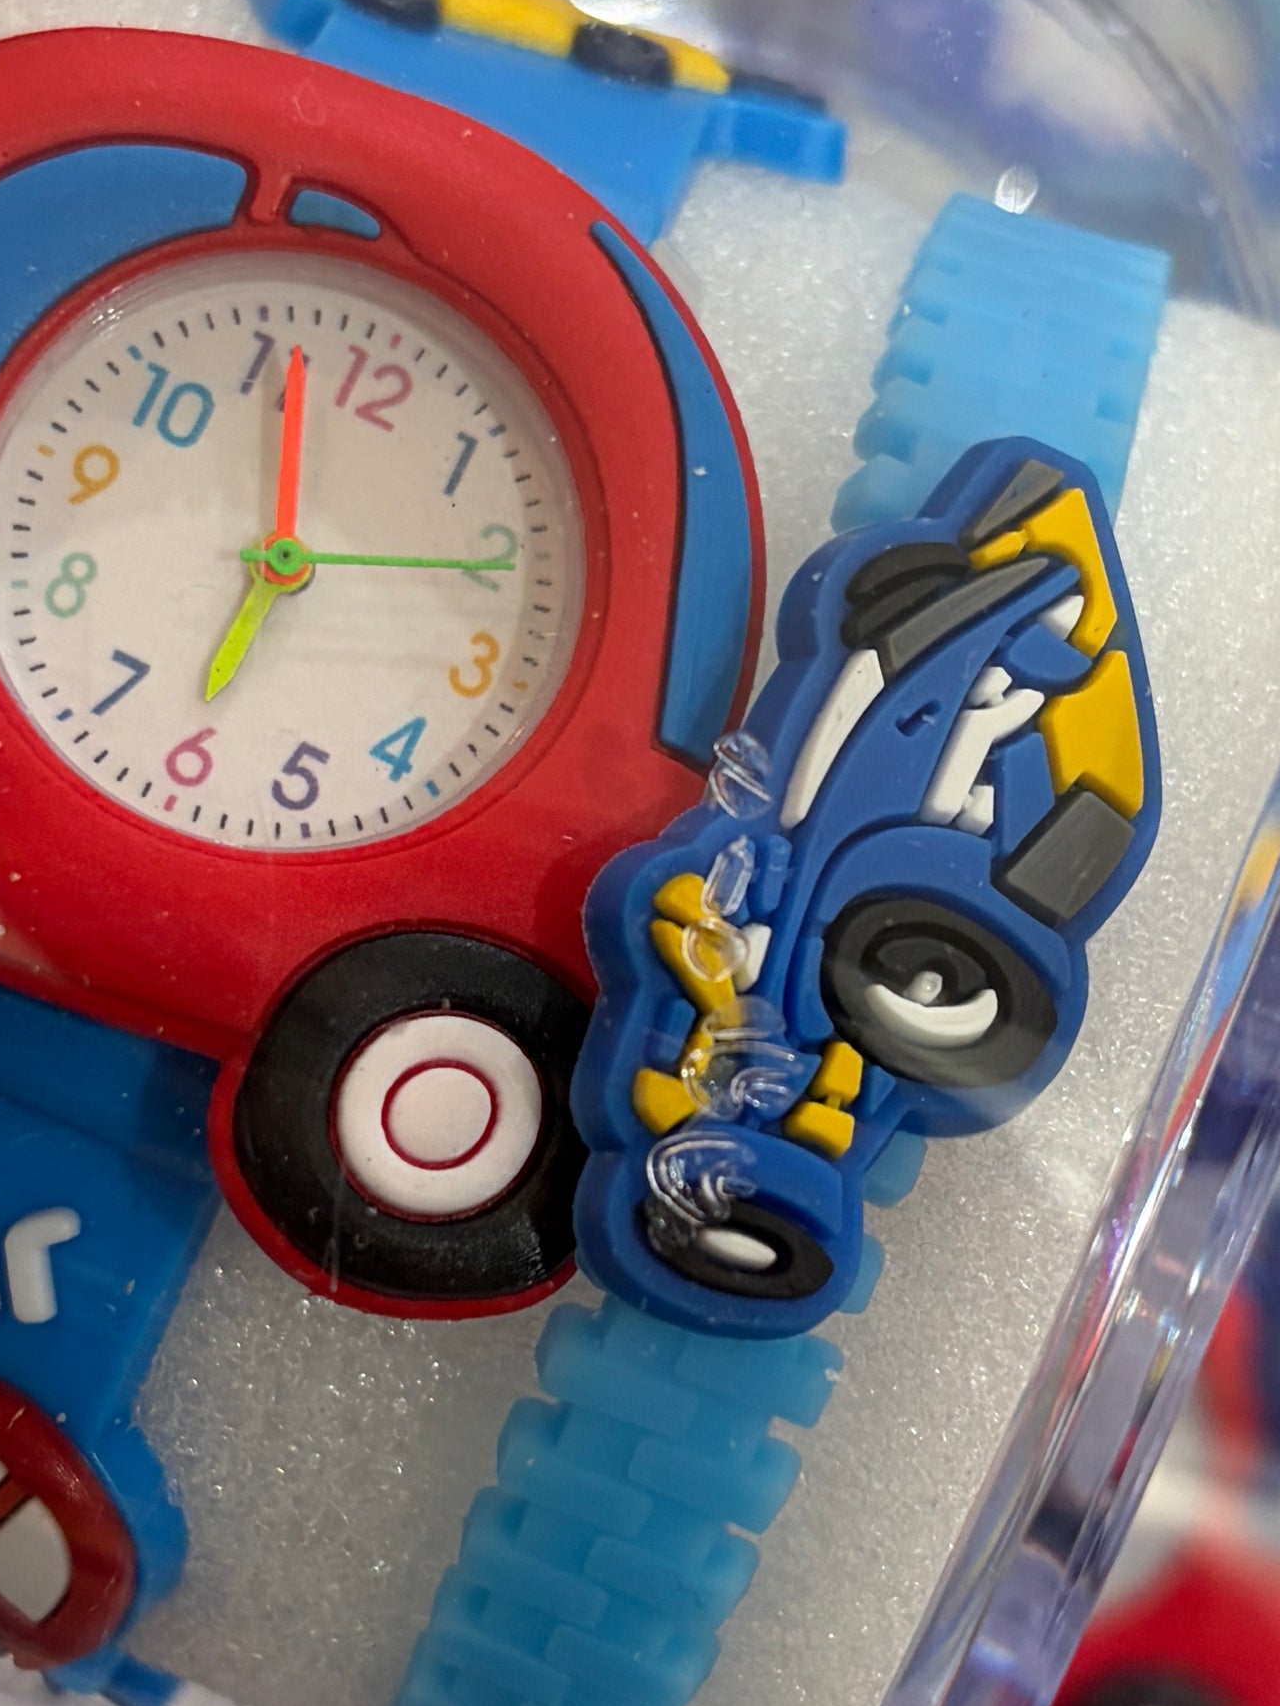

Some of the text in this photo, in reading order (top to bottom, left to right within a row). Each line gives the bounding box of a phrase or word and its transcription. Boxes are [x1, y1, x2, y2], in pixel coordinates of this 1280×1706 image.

[132, 361, 215, 448] 10
[239, 331, 309, 414] 1
[333, 345, 413, 432] 12
[68, 443, 120, 505] 9
[442, 431, 478, 496] 1
[44, 551, 98, 618] 8
[462, 523, 518, 591] 2
[90, 649, 151, 716] 7
[448, 632, 500, 699] 3
[165, 727, 217, 788] 6
[270, 741, 330, 811] 5
[369, 716, 428, 782] 4
